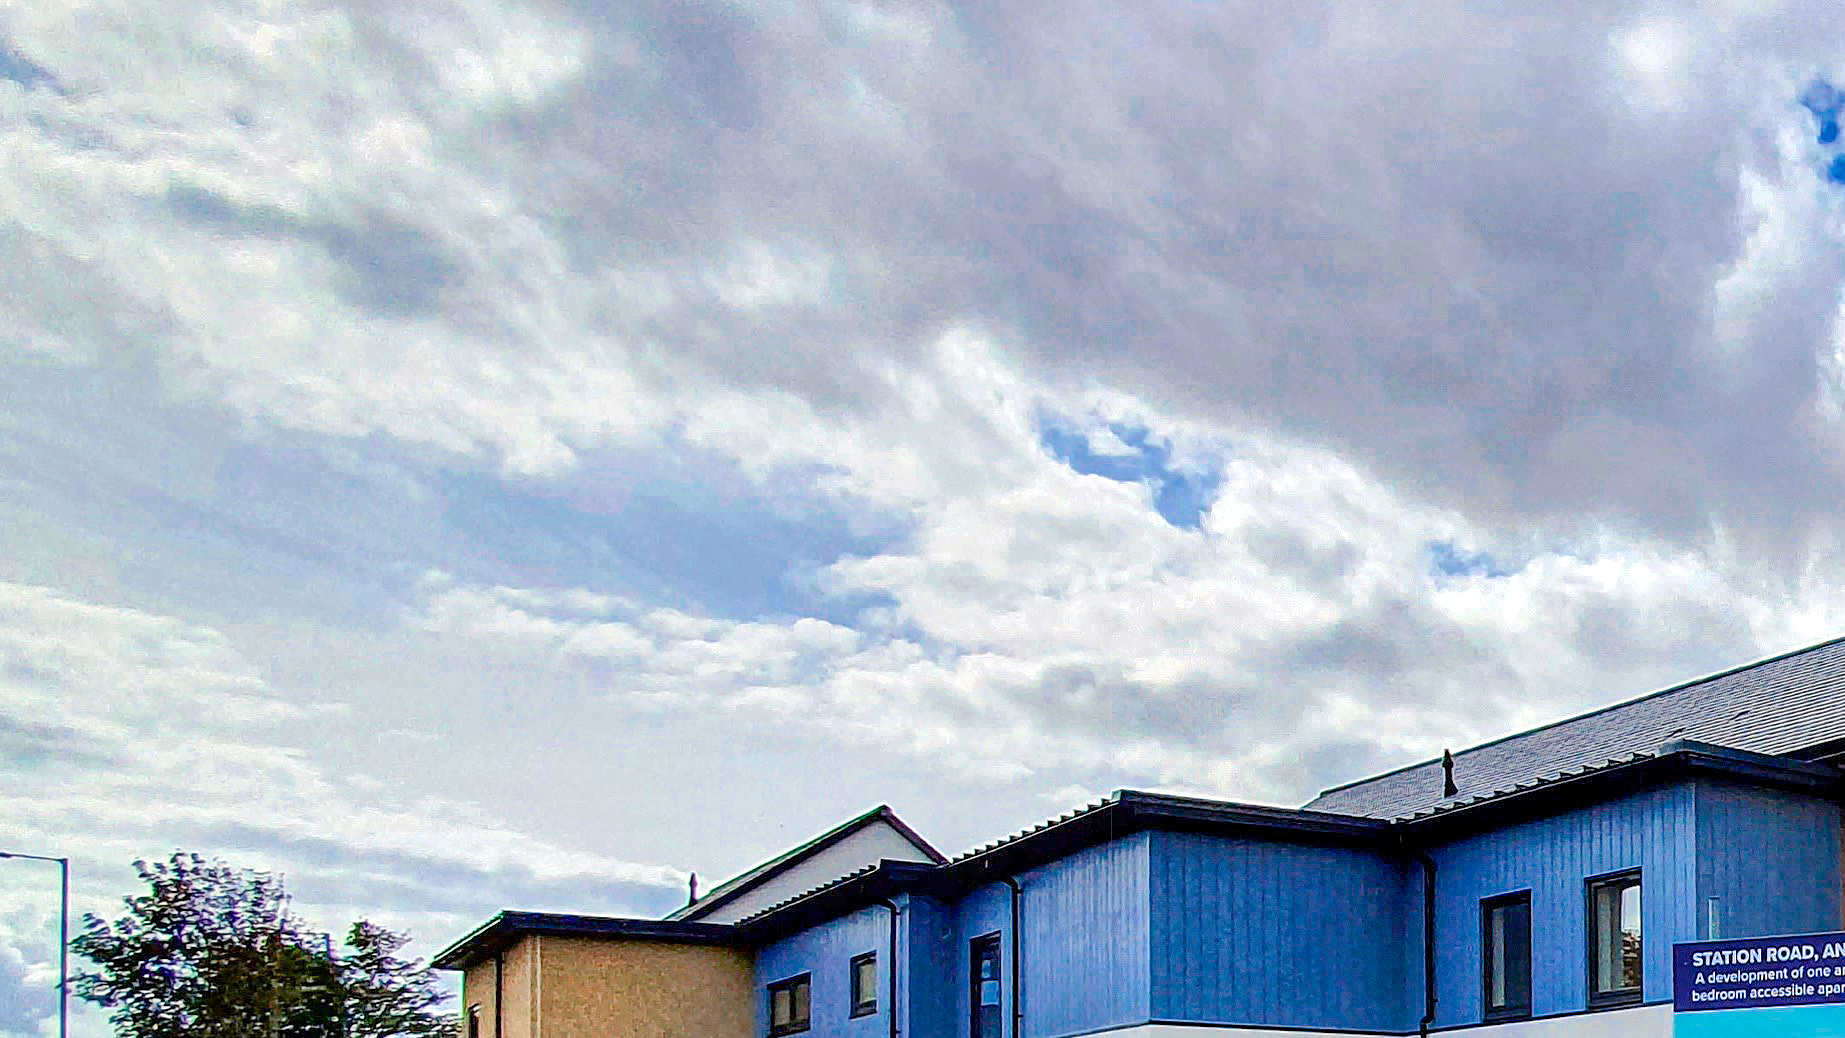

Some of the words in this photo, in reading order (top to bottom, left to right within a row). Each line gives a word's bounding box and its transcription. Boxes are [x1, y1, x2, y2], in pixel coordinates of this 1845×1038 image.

[1692, 947, 1762, 967] STATION
[1766, 944, 1819, 963] ROAD,
[1695, 972, 1705, 984] A
[1708, 968, 1788, 985] development
[1791, 966, 1804, 979] of
[1807, 967, 1830, 978] one
[1692, 988, 1746, 1002] bedroom
[1750, 983, 1814, 999] accessible
